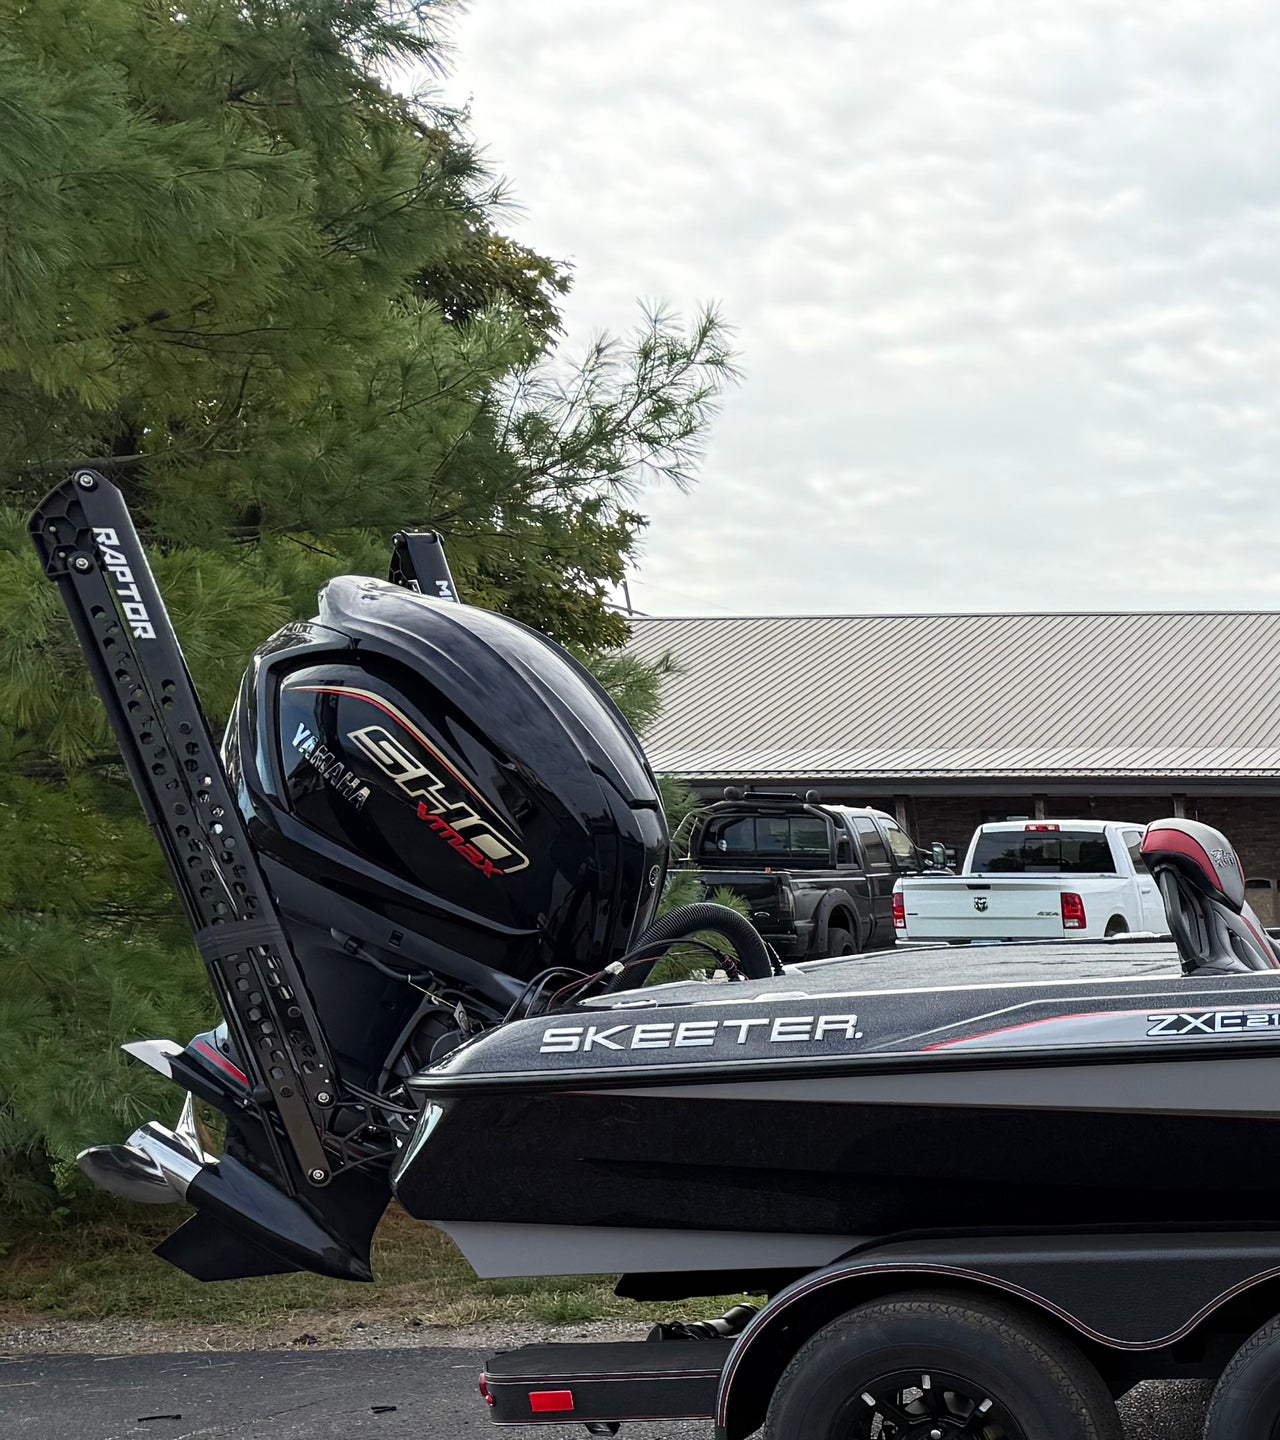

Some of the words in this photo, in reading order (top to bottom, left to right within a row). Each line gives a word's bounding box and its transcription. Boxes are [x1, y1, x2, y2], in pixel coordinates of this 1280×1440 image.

[91, 527, 157, 639] RAPTOR
[291, 722, 372, 813] YAMAHA
[346, 725, 531, 875] SHO
